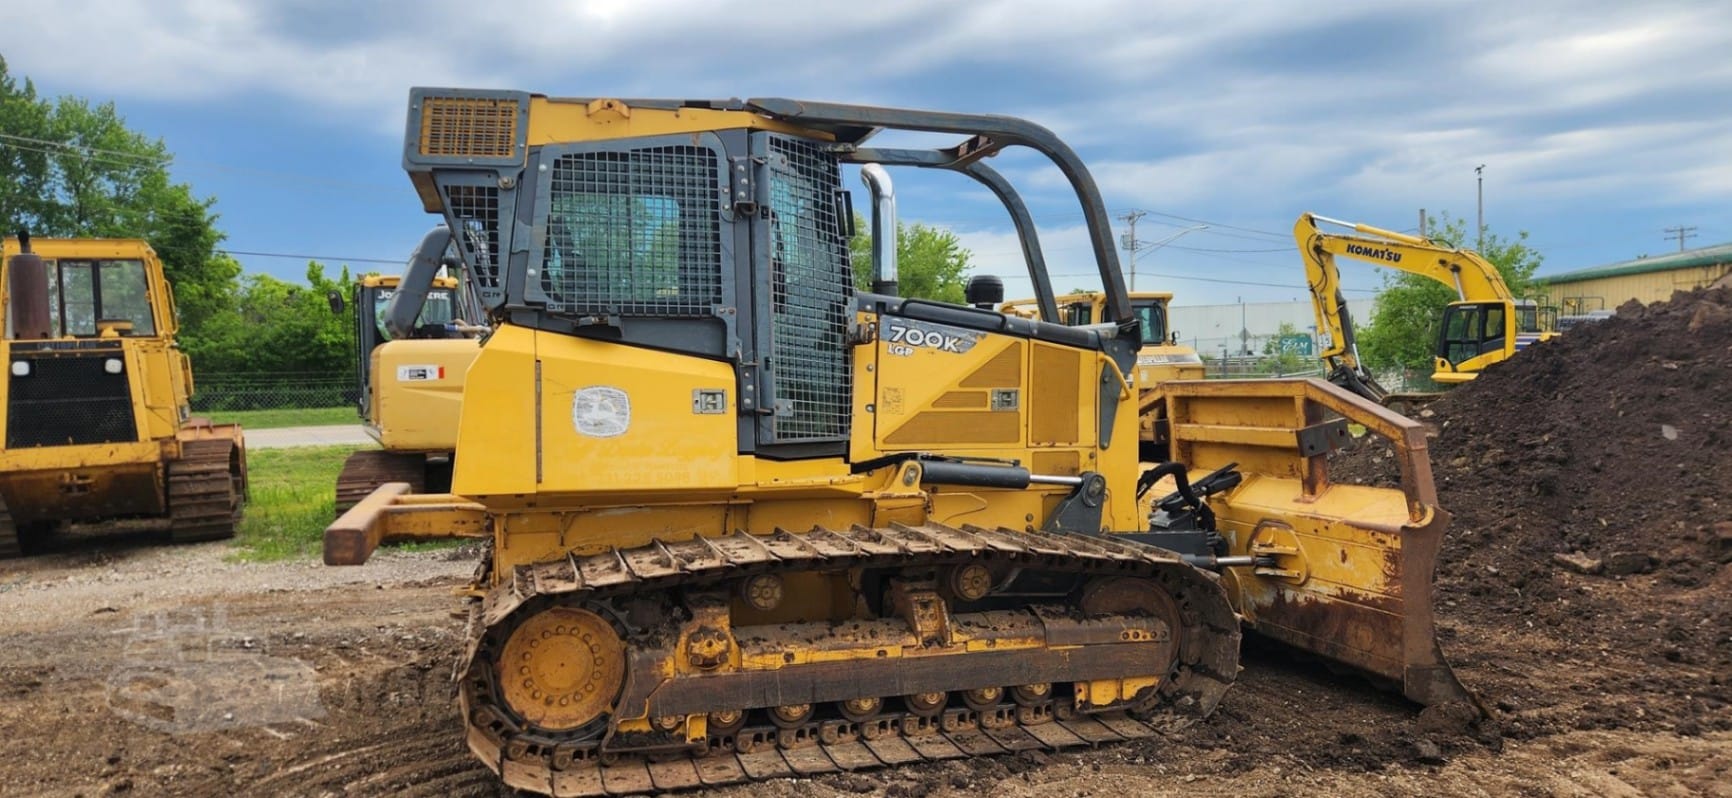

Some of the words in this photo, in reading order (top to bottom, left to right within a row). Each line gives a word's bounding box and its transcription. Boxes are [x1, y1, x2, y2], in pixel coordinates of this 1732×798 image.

[1347, 244, 1402, 262] KOMATSU
[890, 326, 960, 352] 700K
[888, 343, 914, 356] LGP
